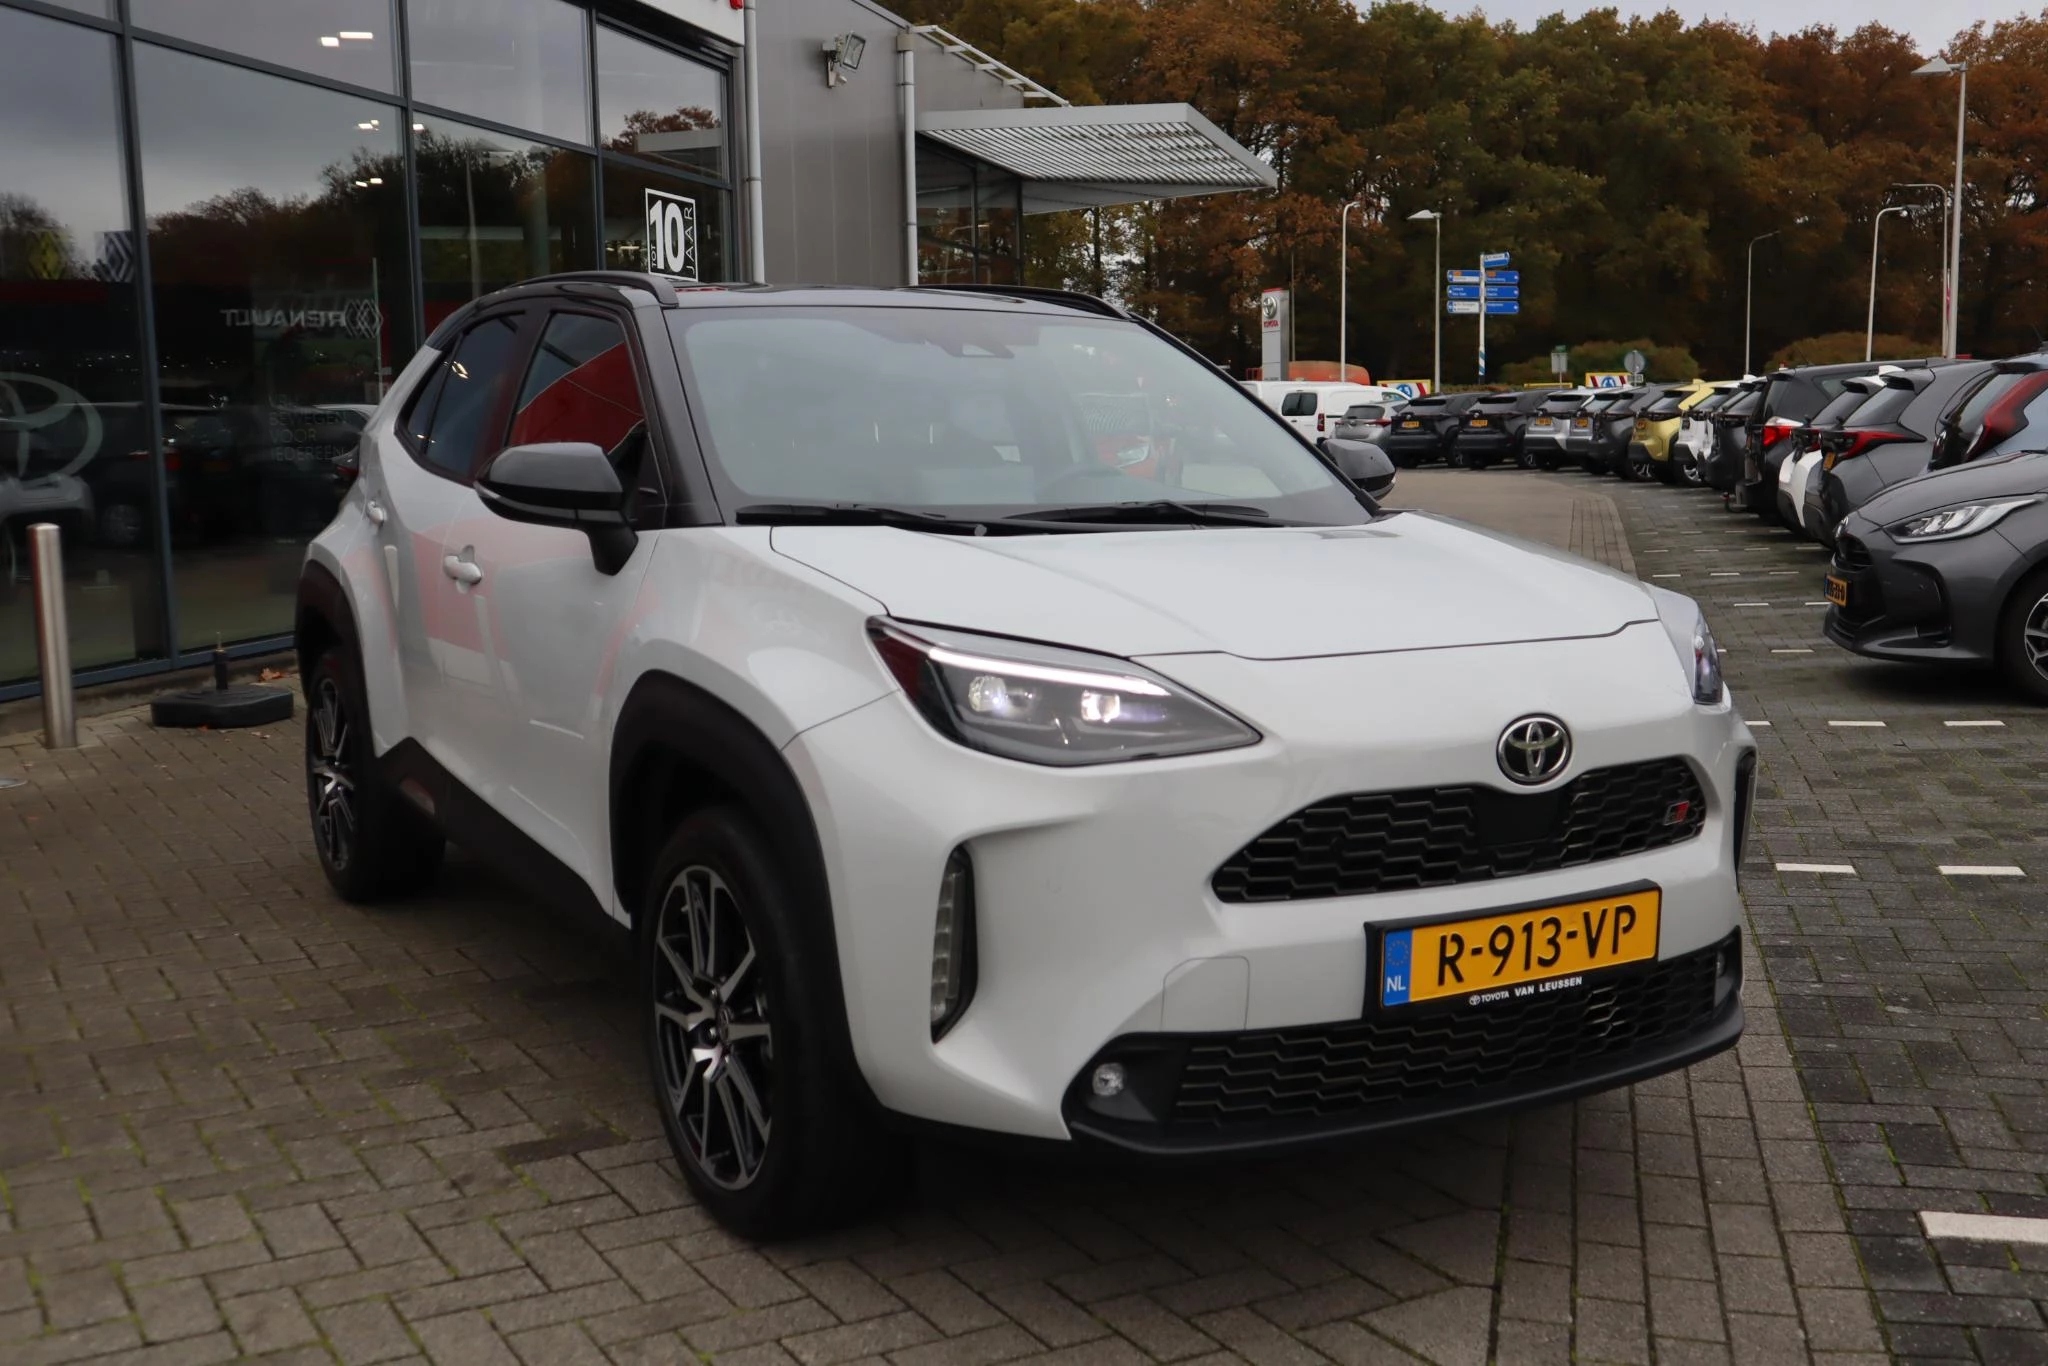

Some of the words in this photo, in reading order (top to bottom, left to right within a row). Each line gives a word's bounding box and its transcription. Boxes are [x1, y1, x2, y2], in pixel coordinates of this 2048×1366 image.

[650, 200, 685, 273] 10
[685, 208, 694, 273] JAAR
[270, 428, 317, 442] VOOR
[1437, 904, 1636, 987] R-913-VP
[1386, 975, 1406, 993] NL
[1481, 989, 1510, 1004] TOYOTA
[1514, 984, 1535, 997] VAN
[1539, 976, 1583, 993] LEUSSEN
